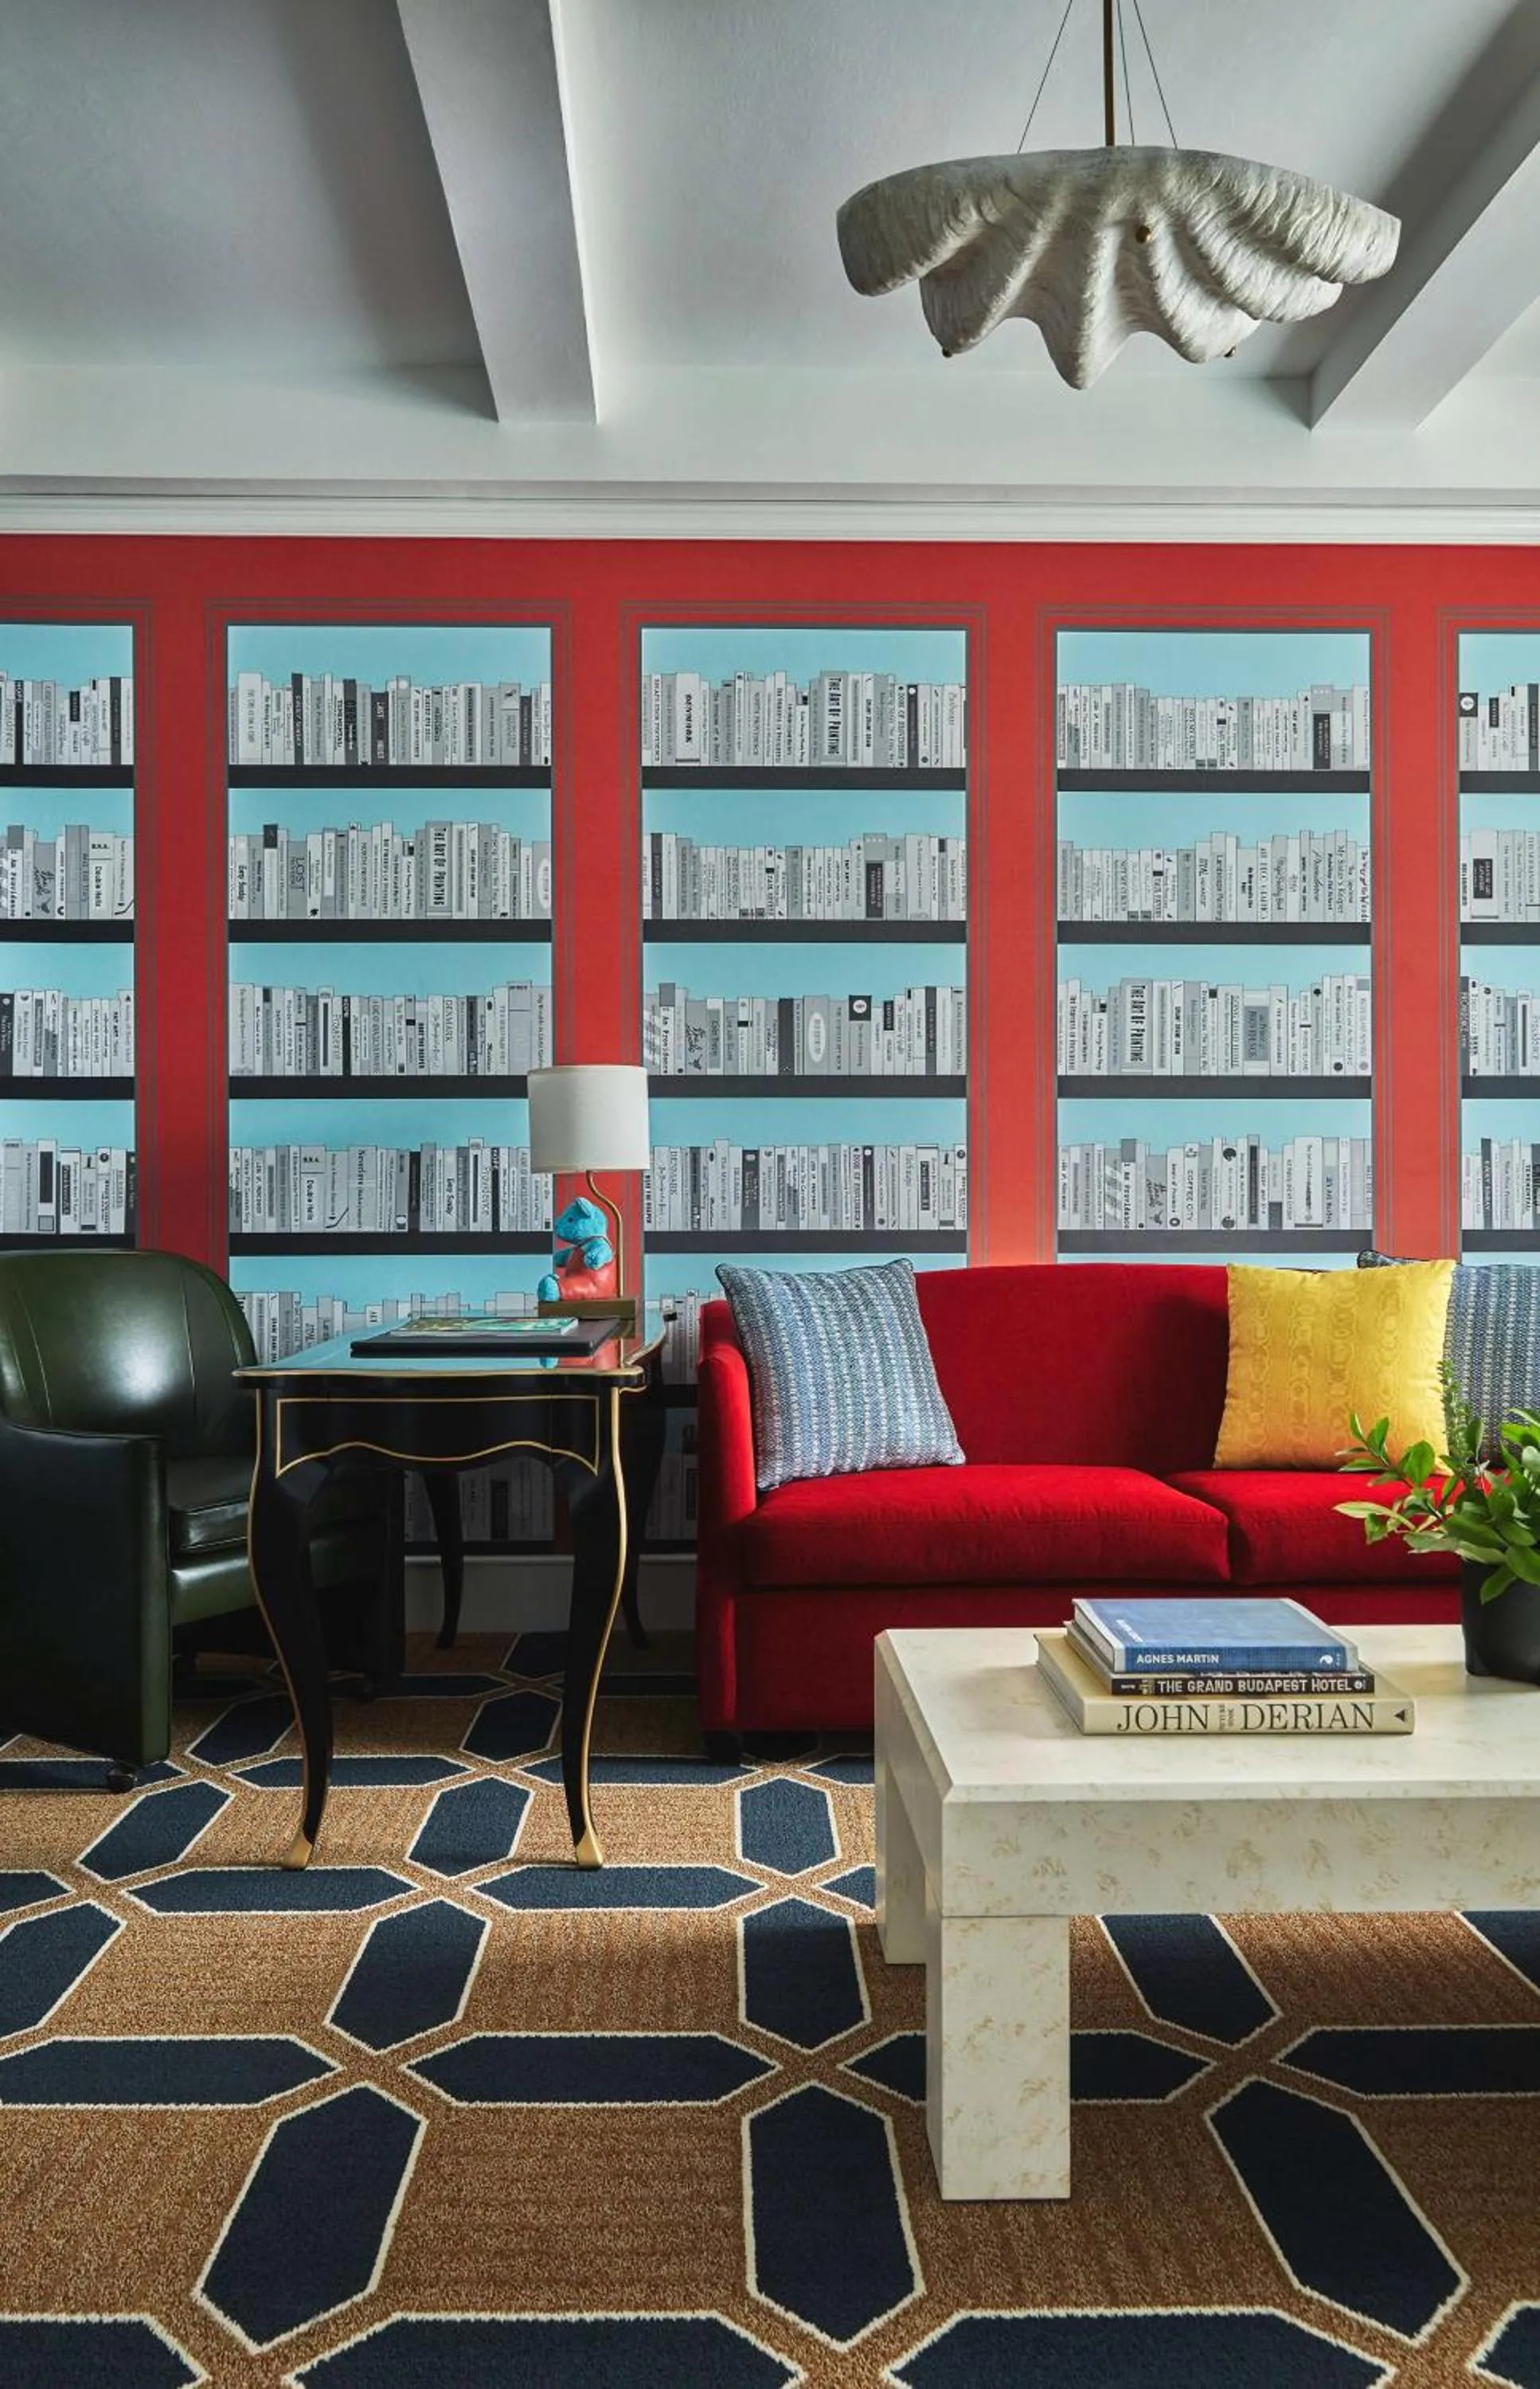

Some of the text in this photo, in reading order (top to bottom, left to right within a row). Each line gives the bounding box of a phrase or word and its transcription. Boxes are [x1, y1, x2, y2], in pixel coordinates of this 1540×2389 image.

[827, 678, 841, 755] THE ART OF PRINTING
[433, 827, 446, 905] THE ART OF PRINTING
[1130, 985, 1145, 1062] THE ART OF PRINTING
[1136, 1654, 1219, 1664] AGNES MARTIN
[1158, 1678, 1353, 1693] THE GRAND BUDAPEST HOTEL
[1117, 1702, 1376, 1731] JOHN DERIAN
